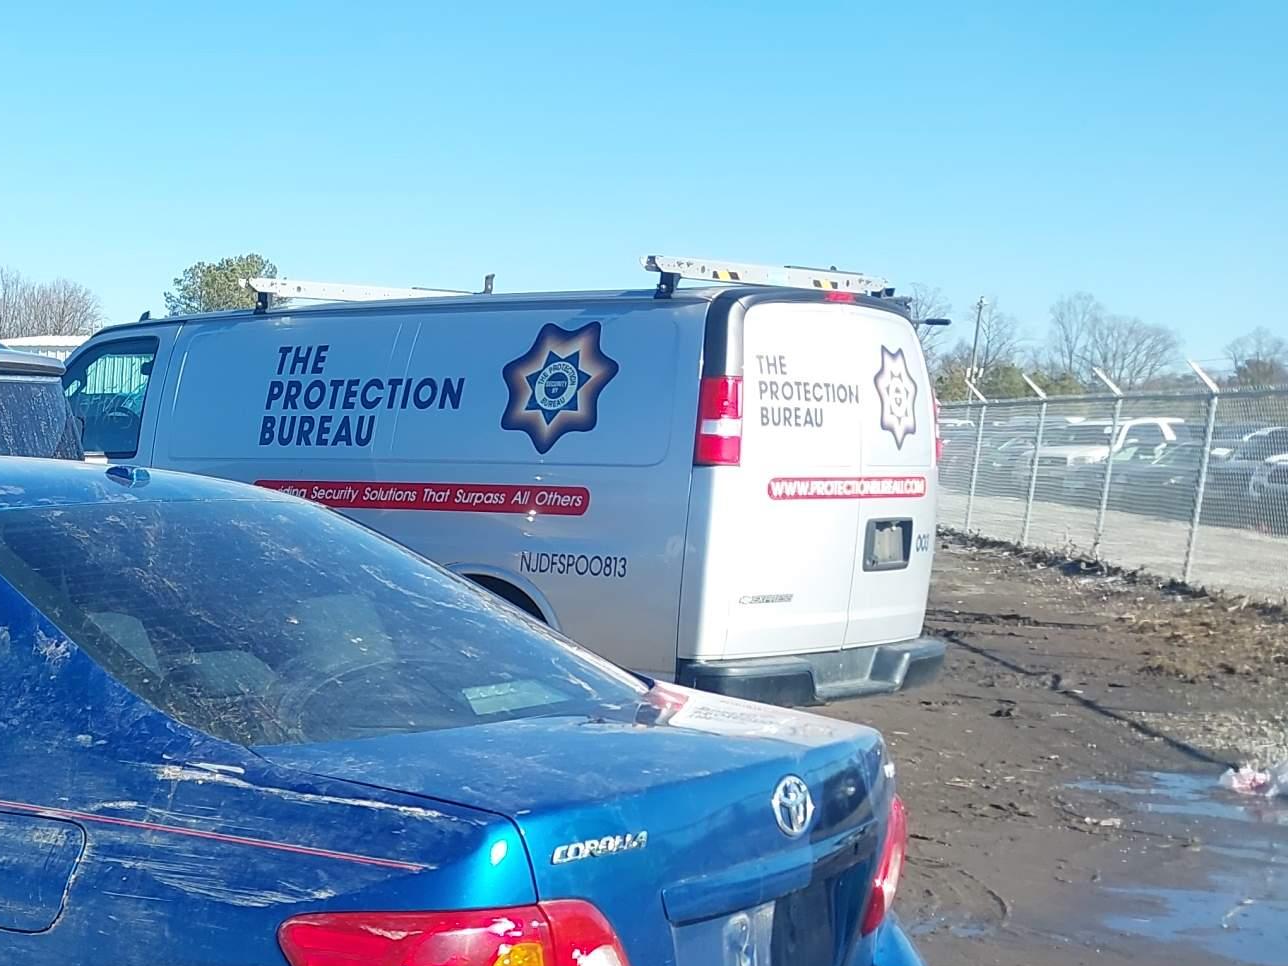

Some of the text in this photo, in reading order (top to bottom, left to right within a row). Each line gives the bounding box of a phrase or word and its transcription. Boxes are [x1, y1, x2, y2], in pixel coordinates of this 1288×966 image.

[276, 344, 329, 375] THE
[756, 355, 788, 375] THE
[538, 363, 577, 386] THE PROTECTION
[265, 377, 465, 410] PROTECTION
[540, 396, 566, 408] BUREAU
[758, 380, 860, 405] PROTECTION
[760, 406, 824, 428] BUREAU
[259, 415, 375, 447] BUREAU
[311, 486, 359, 503] Security
[362, 487, 417, 502] Solutions
[423, 488, 450, 503] That
[454, 489, 506, 506] Surpass
[511, 491, 530, 505] All
[535, 491, 583, 507] Others
[550, 830, 648, 865] COROLLA
